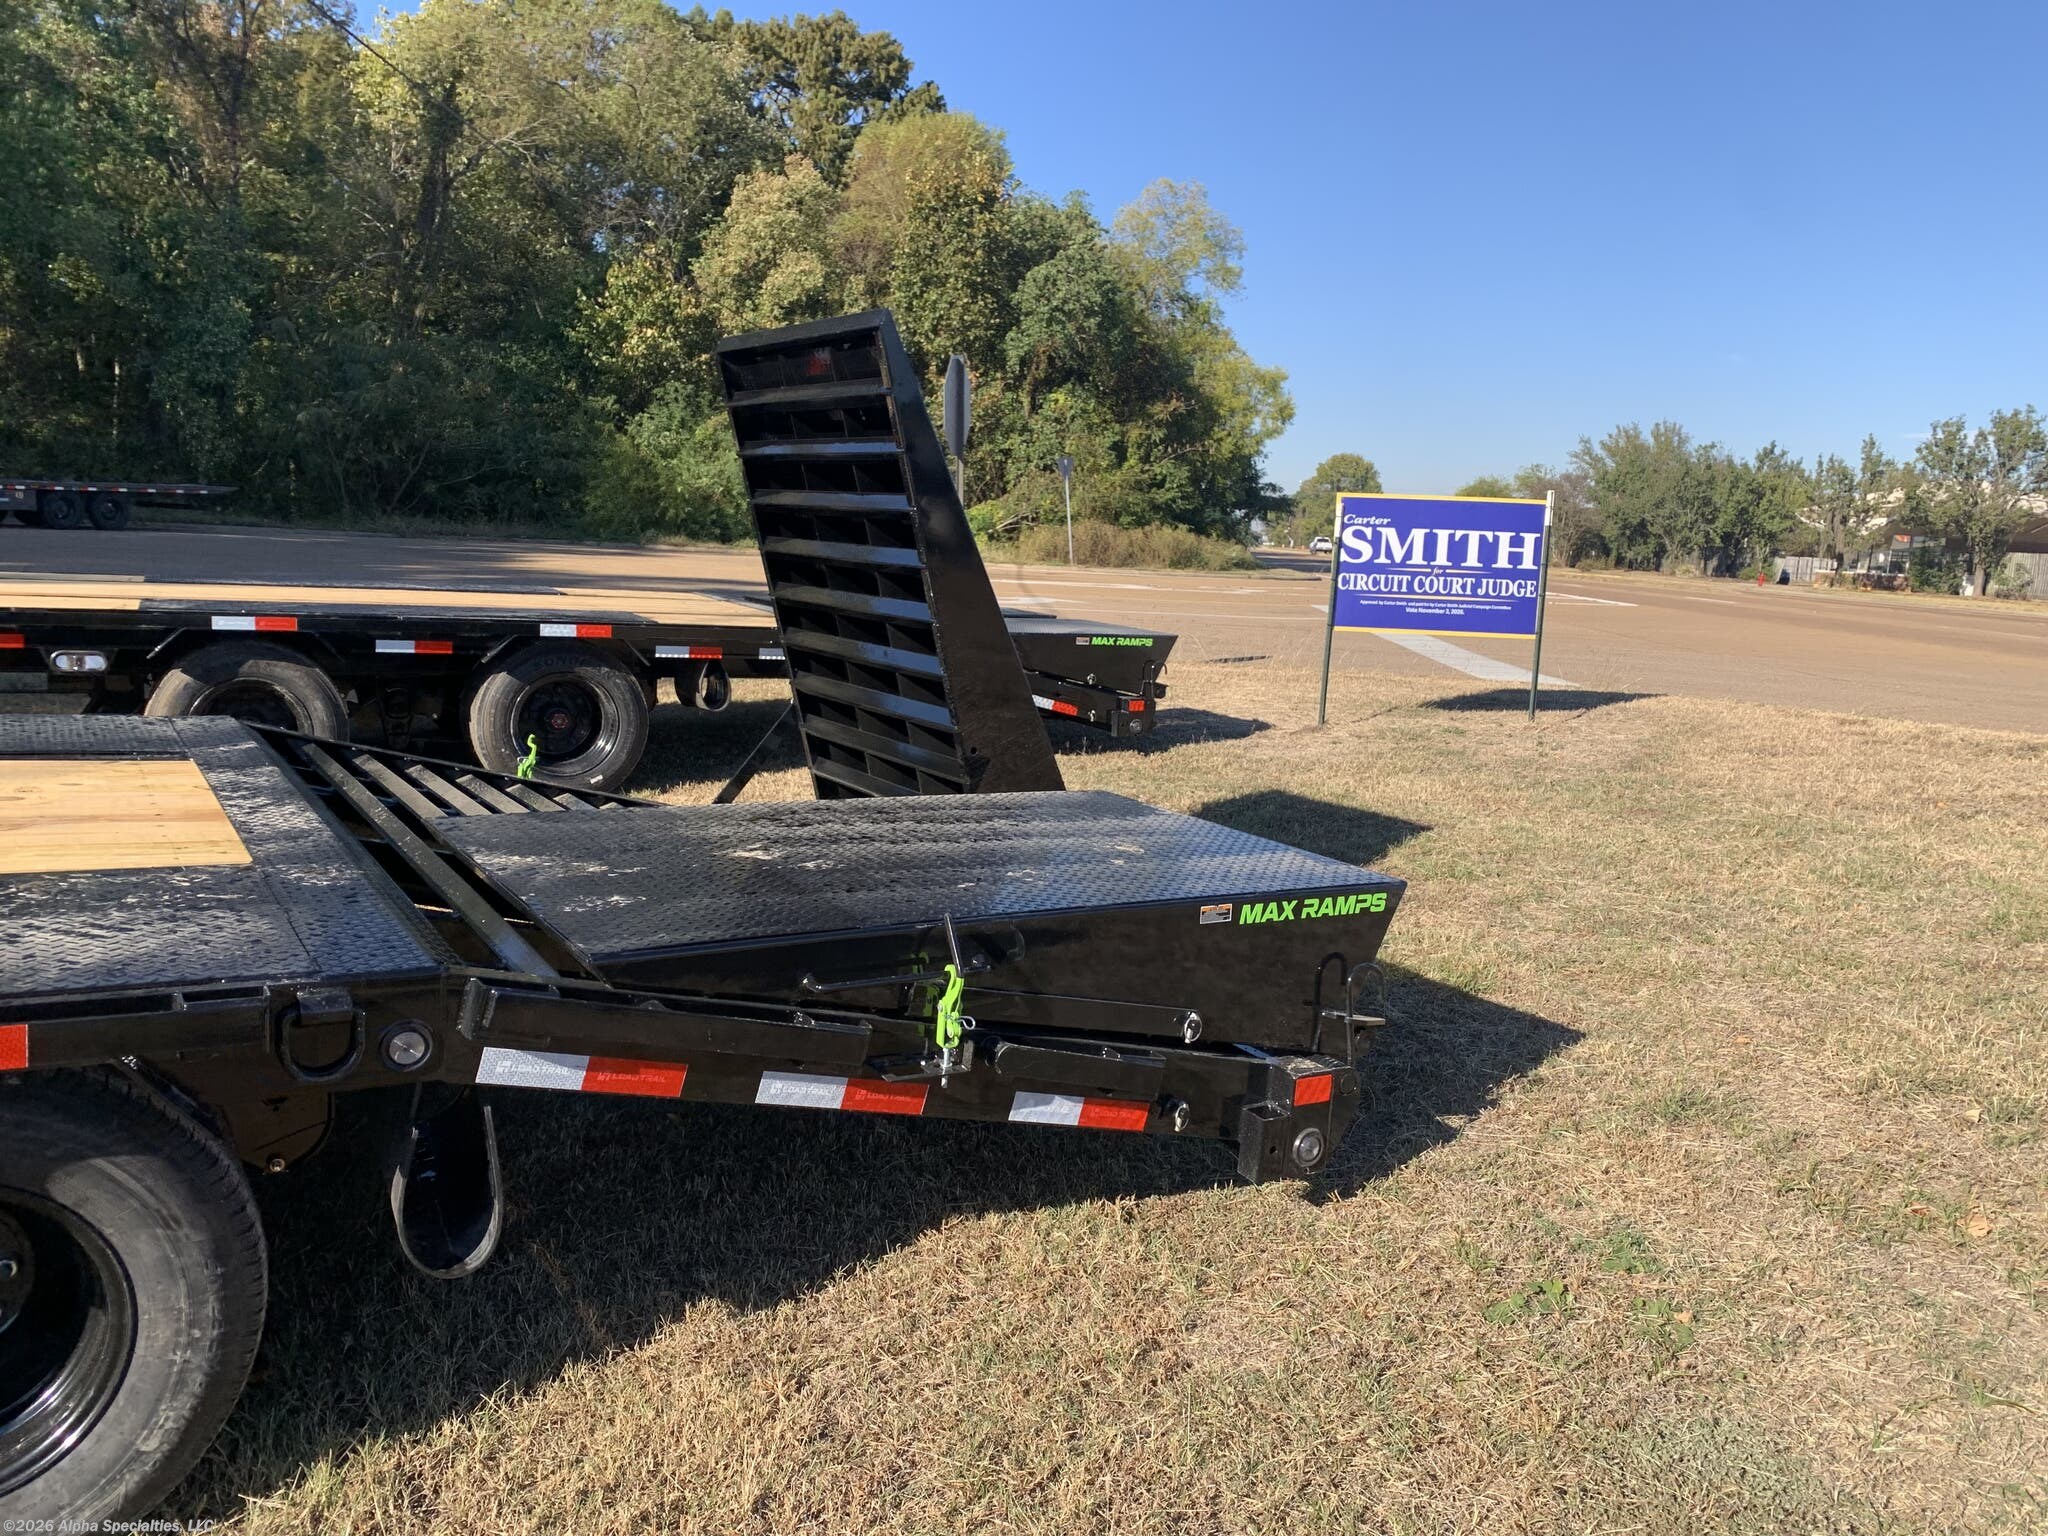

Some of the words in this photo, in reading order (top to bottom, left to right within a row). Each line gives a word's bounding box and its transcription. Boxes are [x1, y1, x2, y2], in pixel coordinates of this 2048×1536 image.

[1343, 513, 1391, 525] Carter
[1340, 525, 1541, 570] SMITH
[1431, 566, 1444, 576] for
[1337, 573, 1411, 593] CIRCUIT
[1413, 575, 1476, 596] COURT
[1477, 578, 1537, 598] JUDGE
[1091, 637, 1115, 646] MAX
[1116, 637, 1153, 647] RAMPS
[1239, 900, 1298, 925] MAX
[1301, 892, 1387, 919] RAMPS
